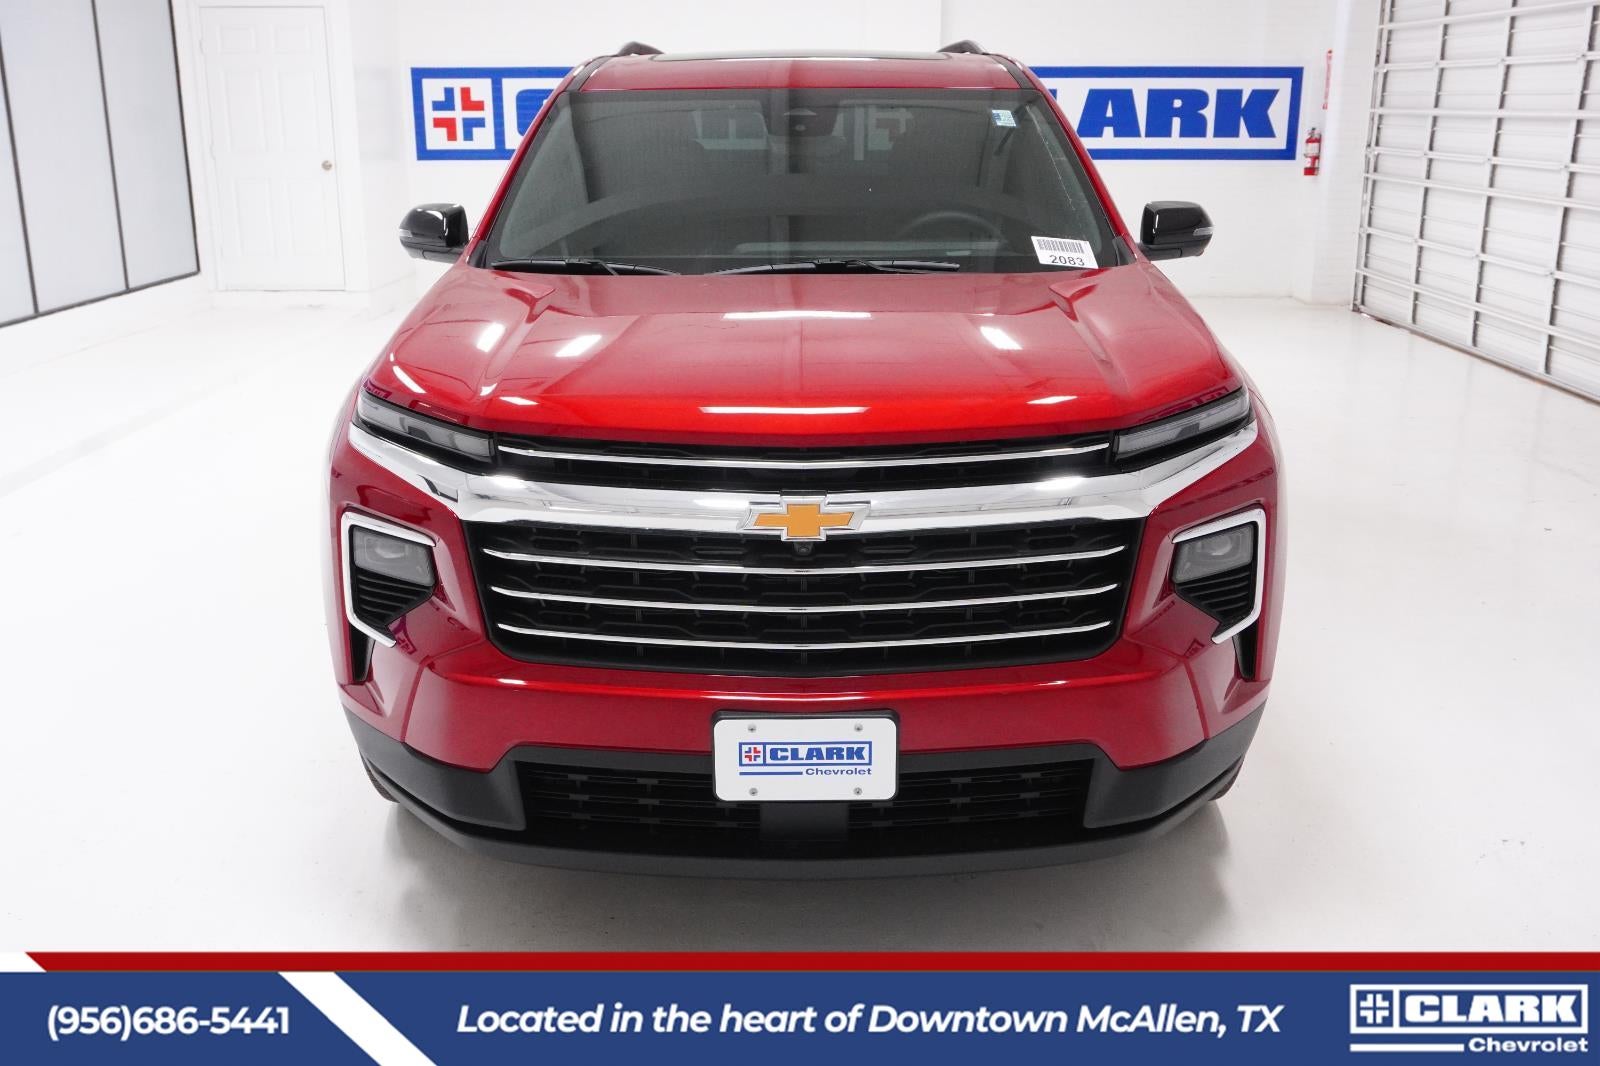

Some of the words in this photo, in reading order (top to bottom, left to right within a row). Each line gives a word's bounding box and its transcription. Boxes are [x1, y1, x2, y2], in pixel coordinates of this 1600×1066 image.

[1051, 88, 1280, 138] ARK
[1049, 254, 1085, 267] 2083
[769, 746, 866, 762] CLARK
[805, 767, 872, 776] Chevrolet
